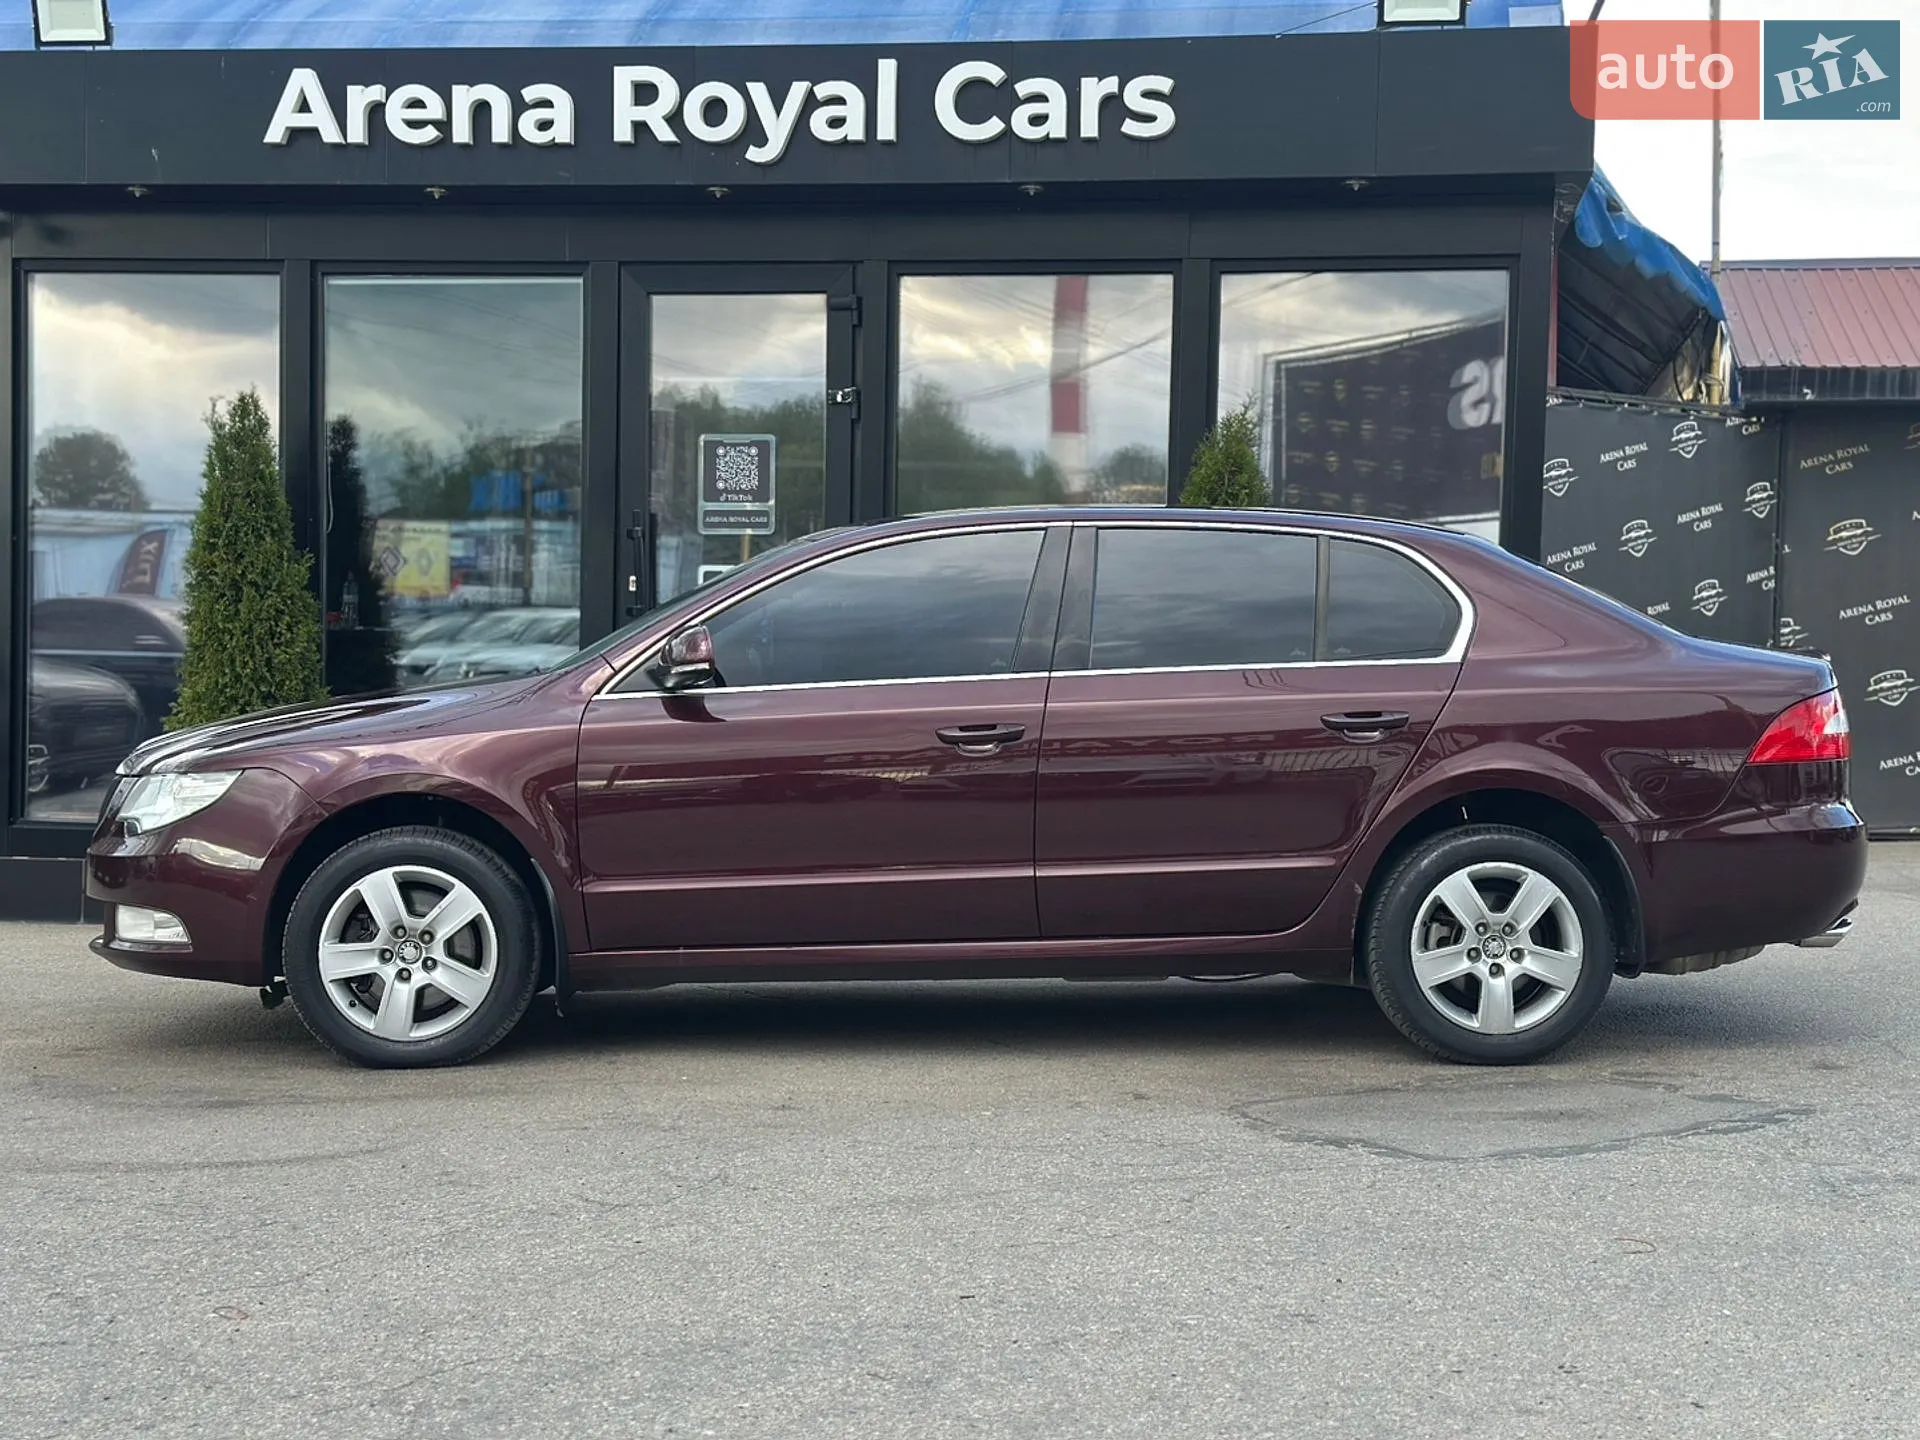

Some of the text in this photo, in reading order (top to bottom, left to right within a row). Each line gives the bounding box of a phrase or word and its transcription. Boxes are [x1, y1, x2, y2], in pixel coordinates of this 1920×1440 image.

[263, 58, 1177, 164] Arena Royal Cars
[1600, 442, 1649, 464] ARENA ROYAL
[1800, 444, 1870, 470] ARENA ROYAL
[1617, 458, 1637, 471] CARS
[1825, 461, 1854, 475] CARS
[1677, 502, 1724, 525] ARENA ROYAL
[1693, 519, 1713, 532] CARS
[1546, 542, 1597, 566] ARENA ROYAL
[1564, 559, 1585, 573] CARS
[1746, 570, 1769, 584] ARENA
[1839, 595, 1911, 620] ARENA ROYAL
[1865, 611, 1894, 625] CARS
[1879, 754, 1915, 770] ARENA
